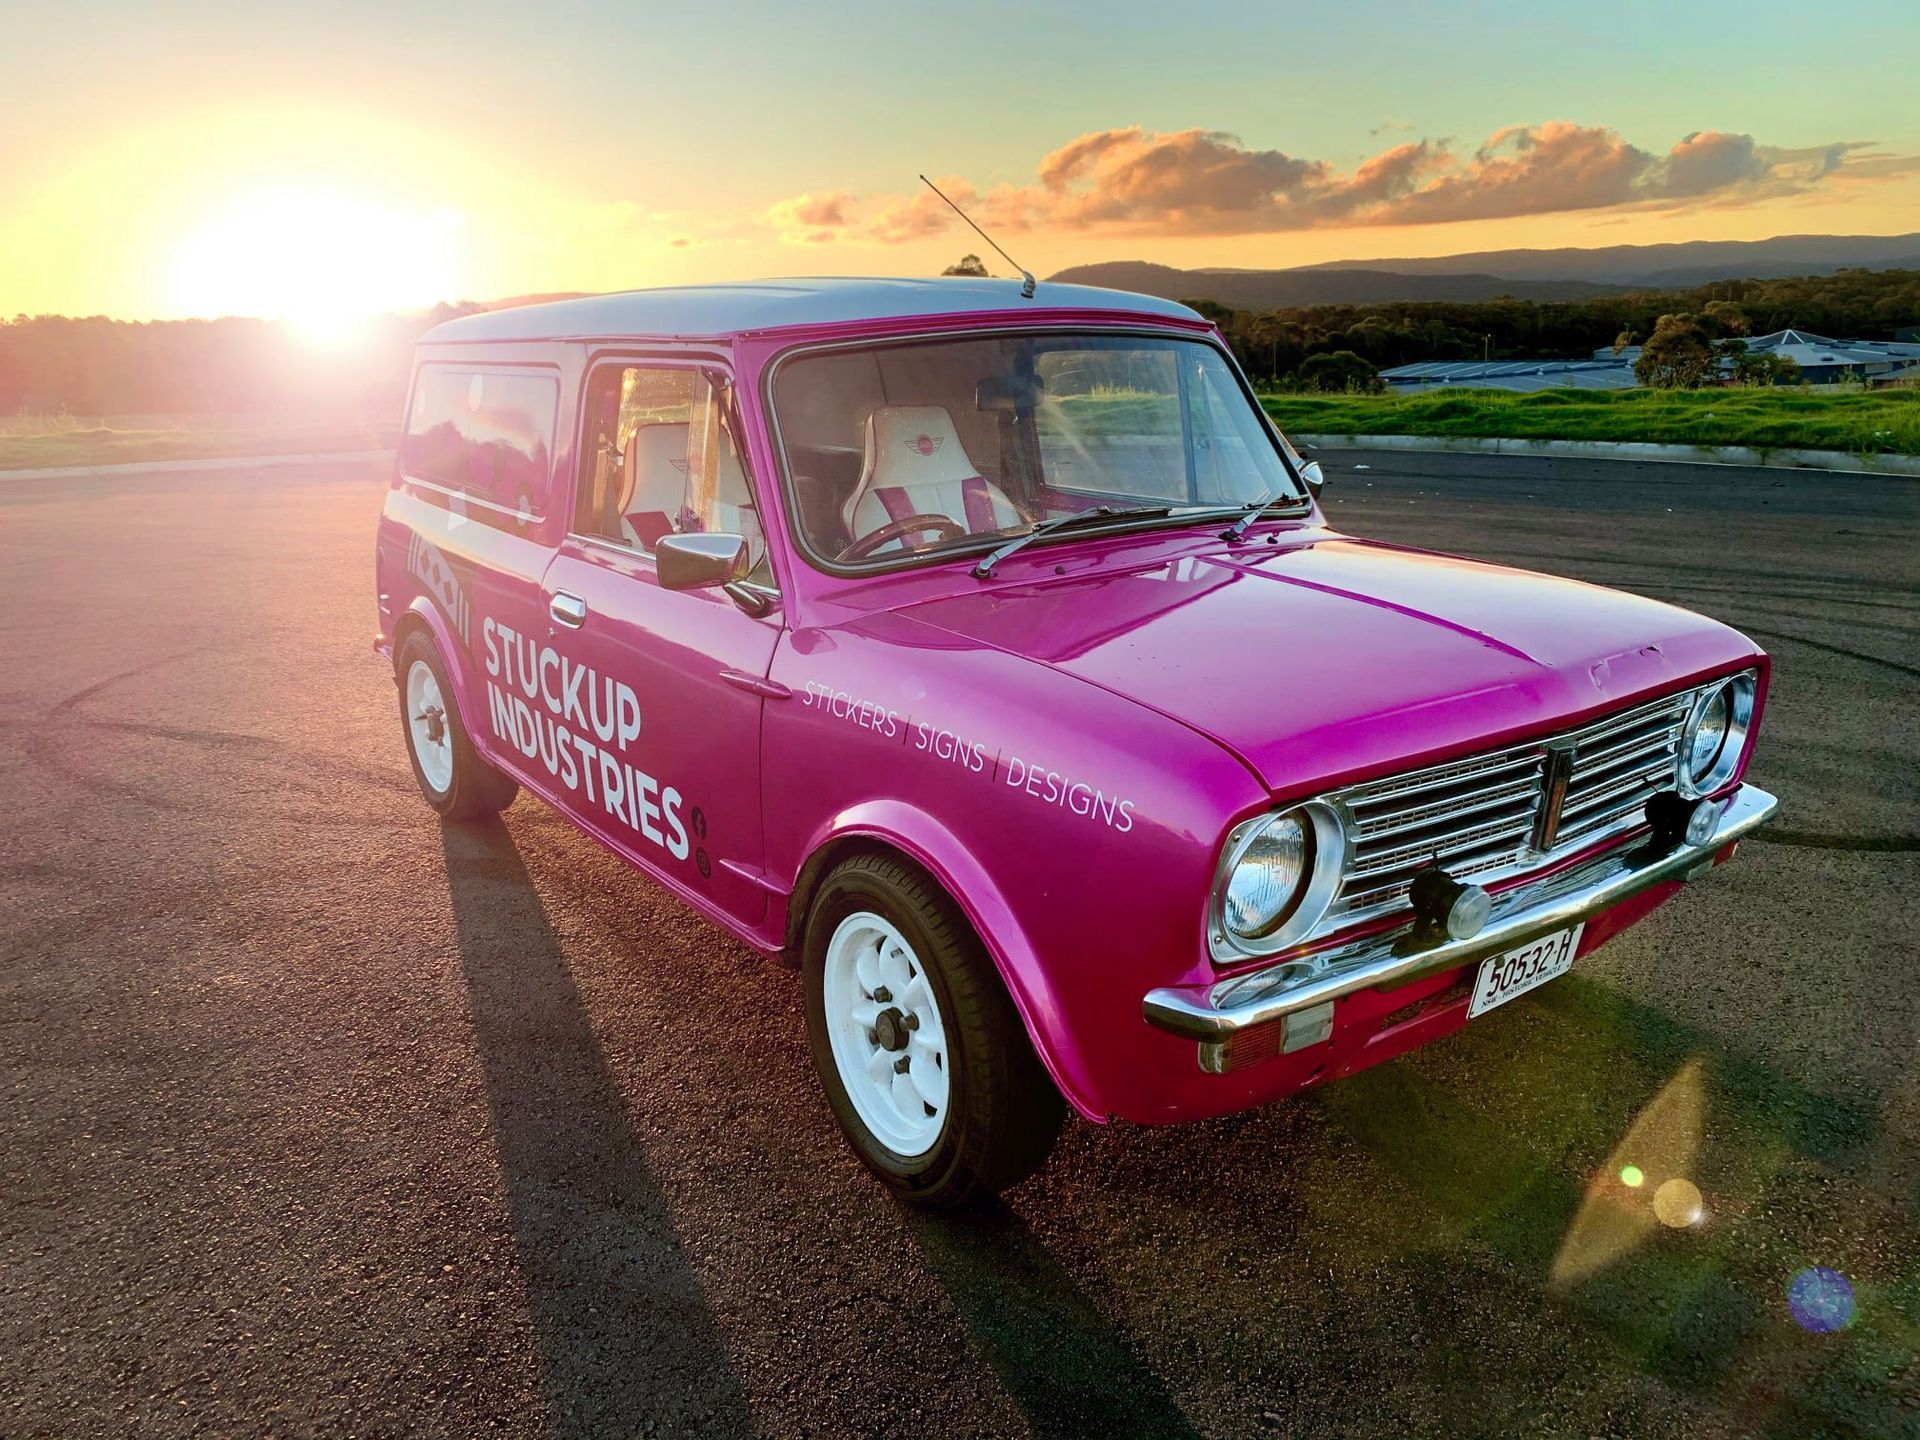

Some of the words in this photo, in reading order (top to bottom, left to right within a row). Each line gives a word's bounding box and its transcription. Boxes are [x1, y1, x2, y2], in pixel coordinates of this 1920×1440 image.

[483, 617, 641, 752] STUCKUP
[802, 680, 898, 737] STICKERS
[915, 722, 986, 772] SIGNS
[1006, 757, 1135, 833] DESIGNS
[488, 682, 689, 861] INDUSTRIES
